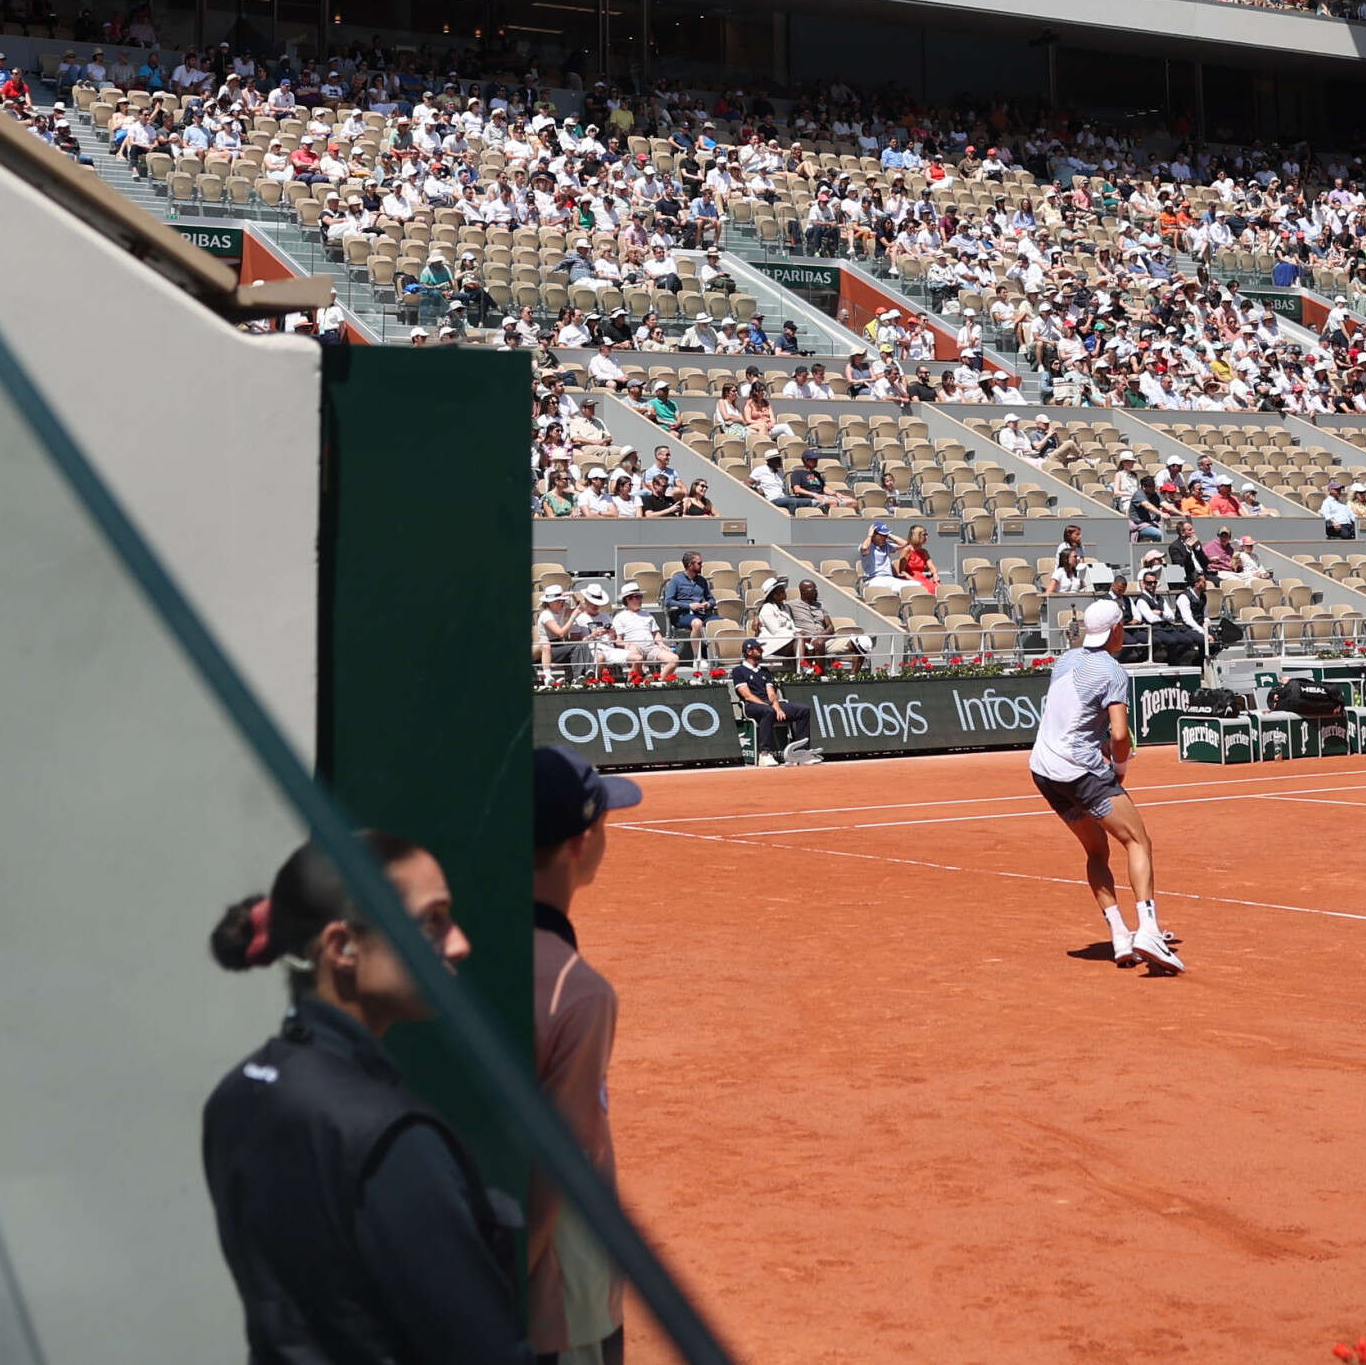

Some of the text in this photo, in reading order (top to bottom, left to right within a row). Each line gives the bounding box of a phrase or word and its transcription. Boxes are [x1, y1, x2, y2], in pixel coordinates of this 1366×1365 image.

[774, 268, 832, 284] PARIBAS
[558, 702, 720, 752] oppo
[812, 694, 929, 743] Infosys
[952, 688, 1047, 731] Infosy
[1140, 682, 1190, 737] perrie
